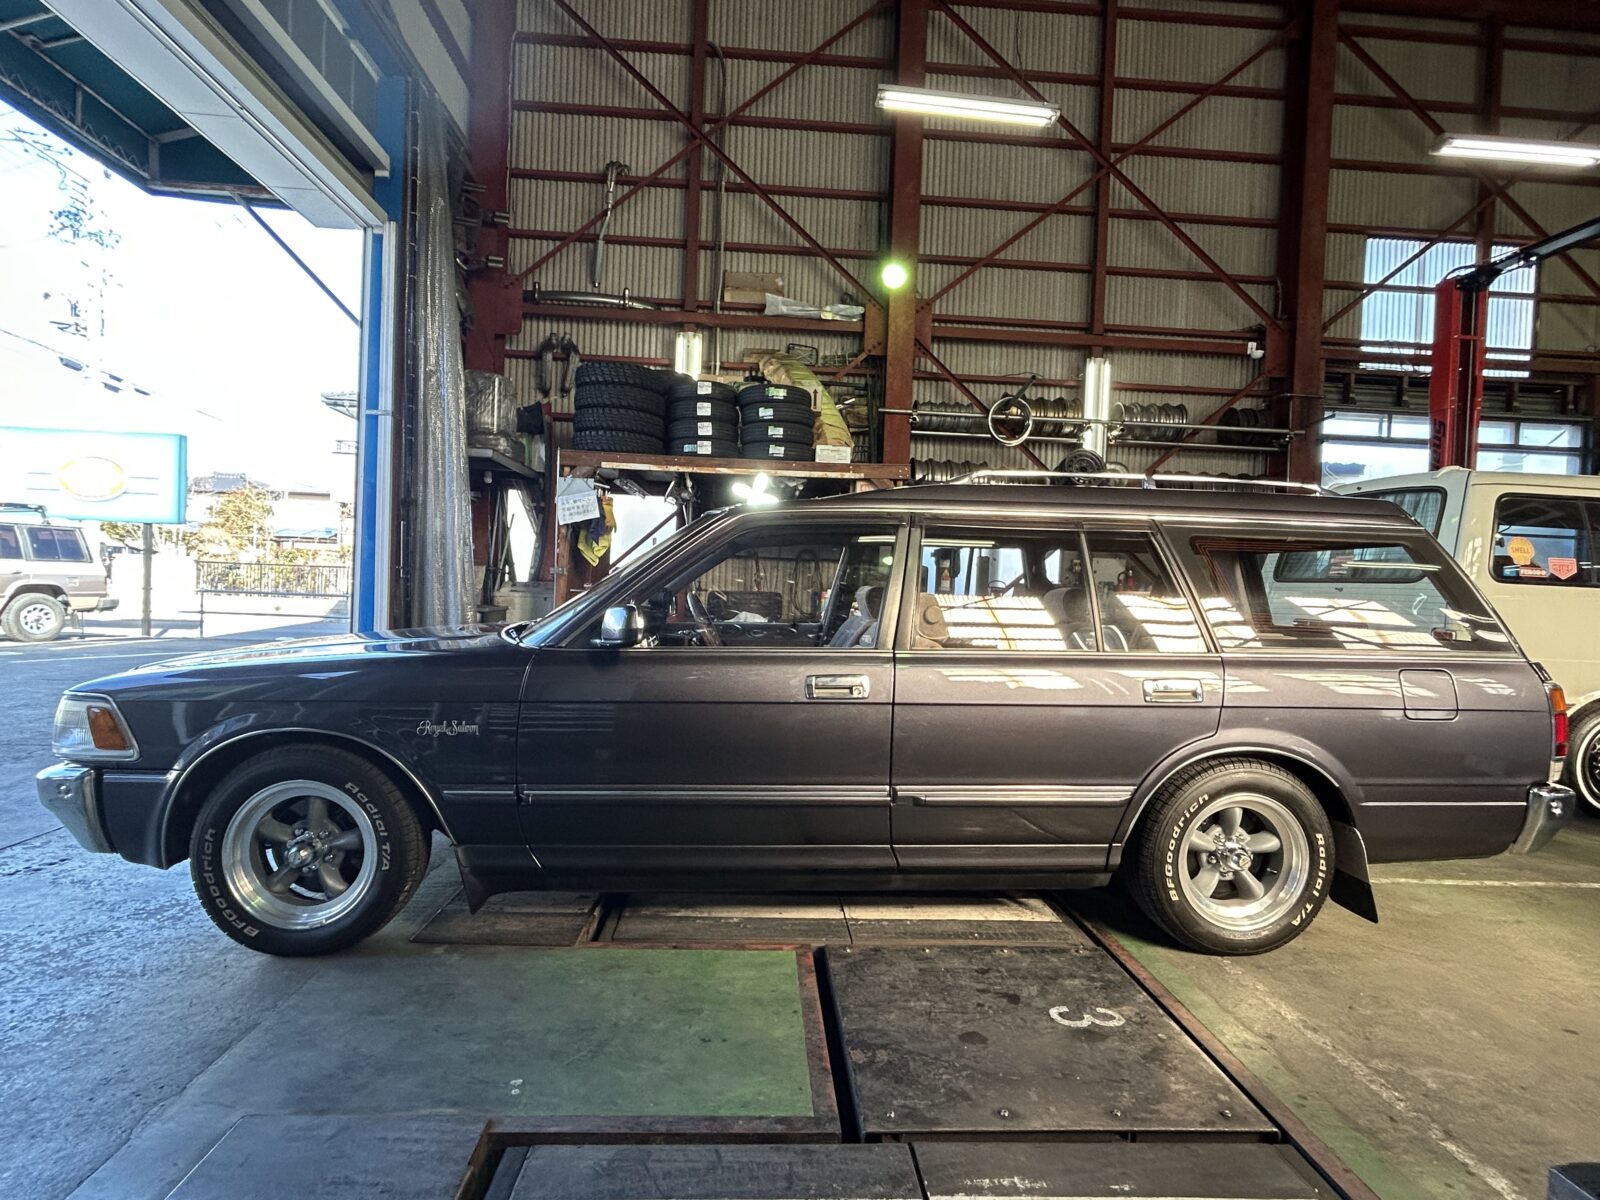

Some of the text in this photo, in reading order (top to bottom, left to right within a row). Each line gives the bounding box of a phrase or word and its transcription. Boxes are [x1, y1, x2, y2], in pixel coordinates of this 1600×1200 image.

[1511, 546, 1531, 554] SHELL
[416, 720, 480, 738] Royal Saloon
[345, 783, 392, 871] Radial T/A
[1164, 793, 1209, 902] BFGoodrich
[201, 828, 260, 938] BFGoodrich
[1292, 833, 1328, 927] Radial T/A
[1048, 1005, 1126, 1028] 3
